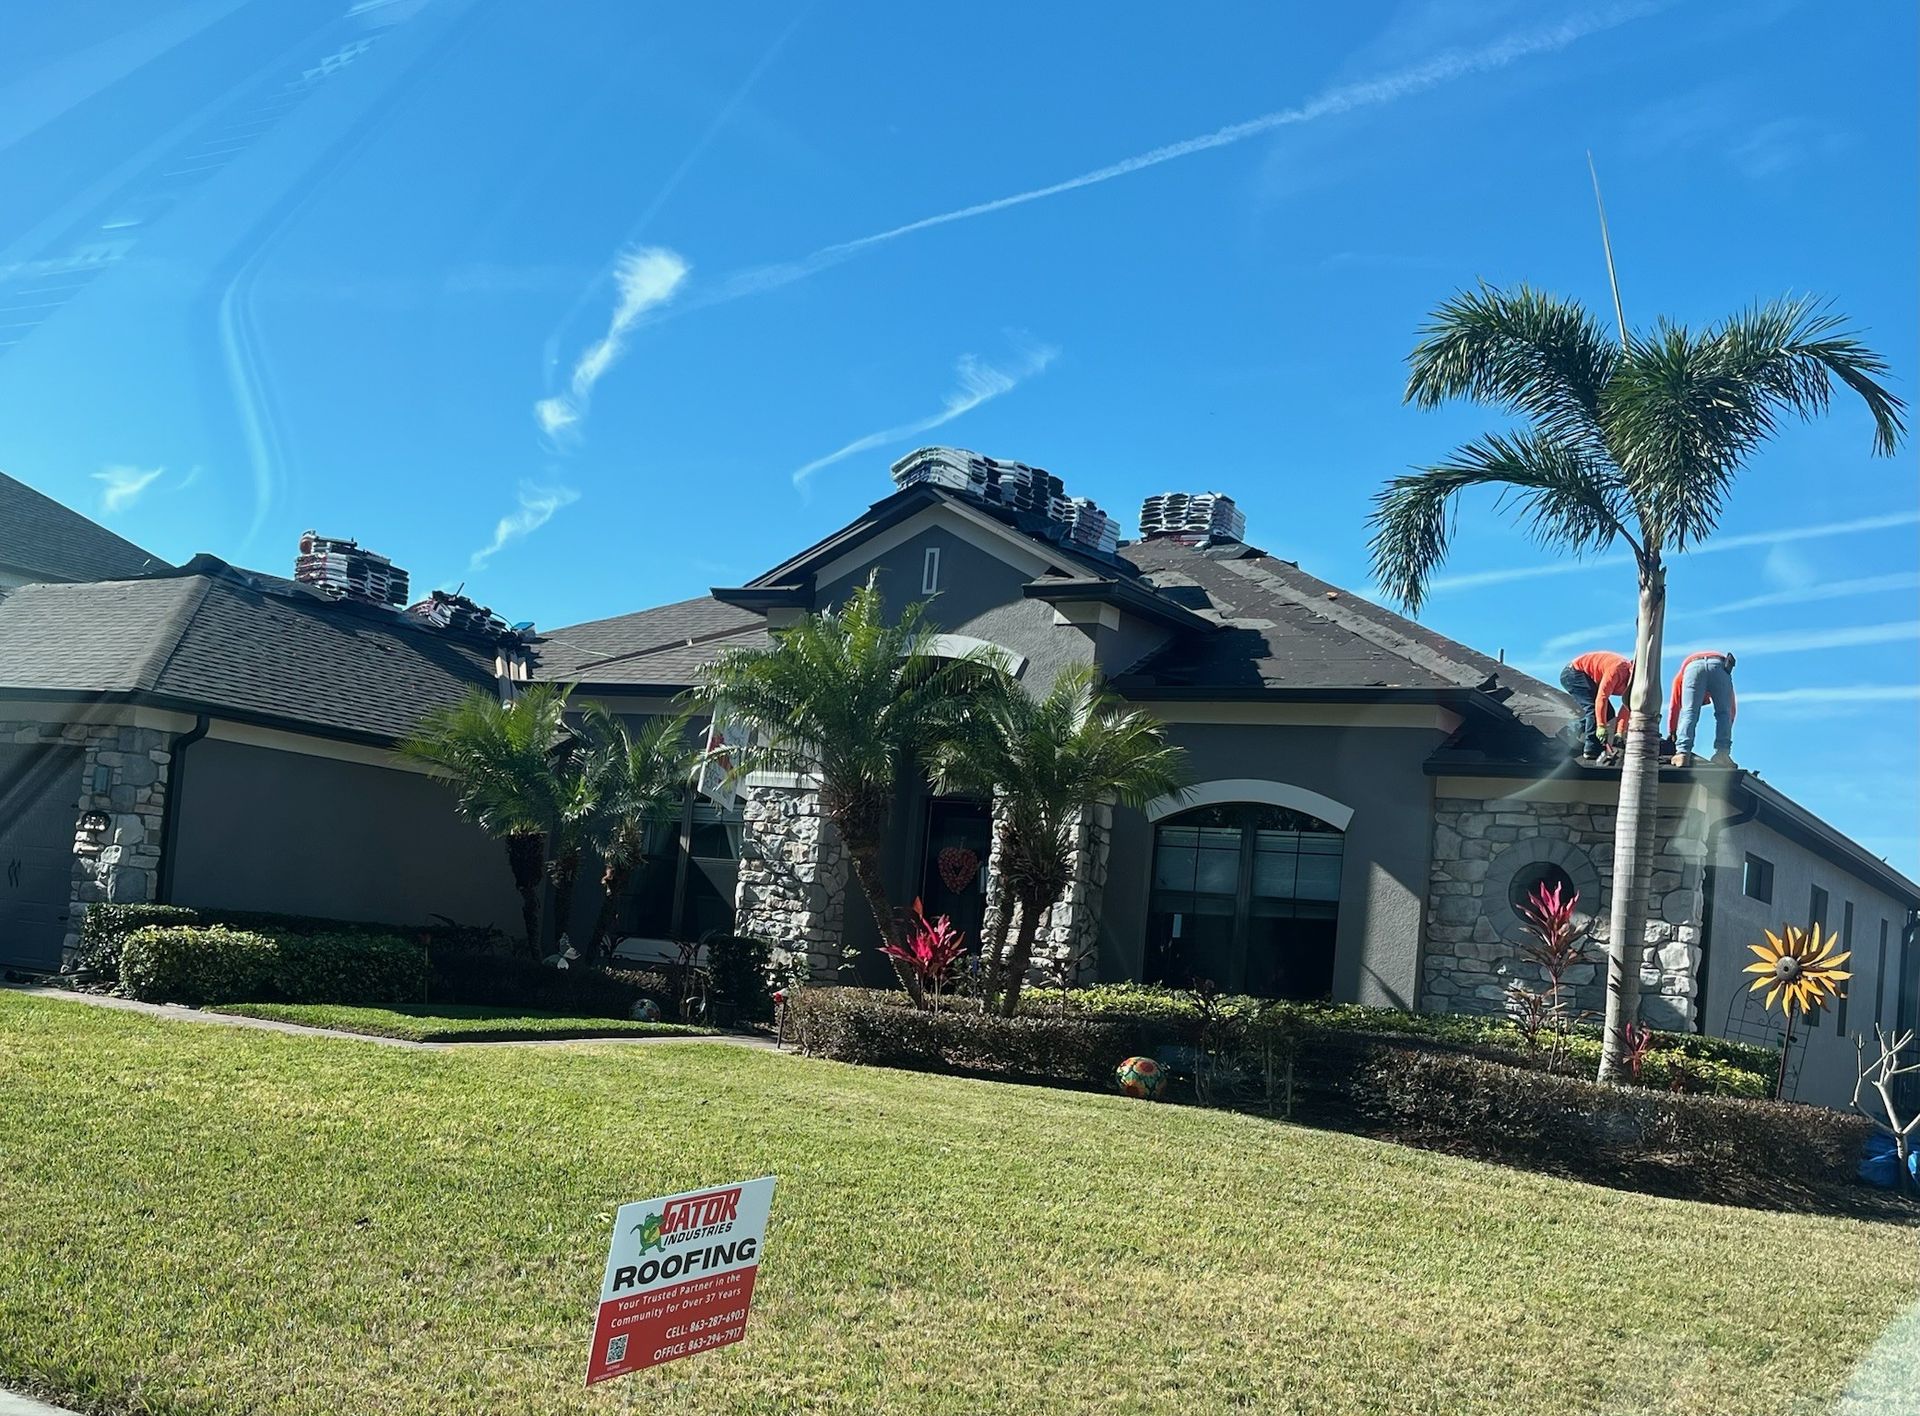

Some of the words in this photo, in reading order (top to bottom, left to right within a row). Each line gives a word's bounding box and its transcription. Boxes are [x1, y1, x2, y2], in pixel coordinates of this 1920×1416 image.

[660, 1188, 742, 1235] GATOR
[664, 1222, 733, 1246] INDUSTRIES
[613, 1238, 758, 1292] ROOFING
[611, 1307, 663, 1328] Community
[666, 1302, 679, 1313] for
[682, 1297, 702, 1309] Over
[705, 1295, 716, 1303] 37
[719, 1288, 741, 1300] Years
[618, 1300, 639, 1311] Your
[643, 1290, 677, 1305] Trusted
[679, 1281, 713, 1295] Partner
[716, 1277, 724, 1286] in
[727, 1274, 741, 1283] the
[666, 1326, 688, 1340] CELL:
[690, 1309, 745, 1333] 863-287-6903
[653, 1344, 686, 1361] OFFICE:
[688, 1327, 742, 1350] 863-294-7917
